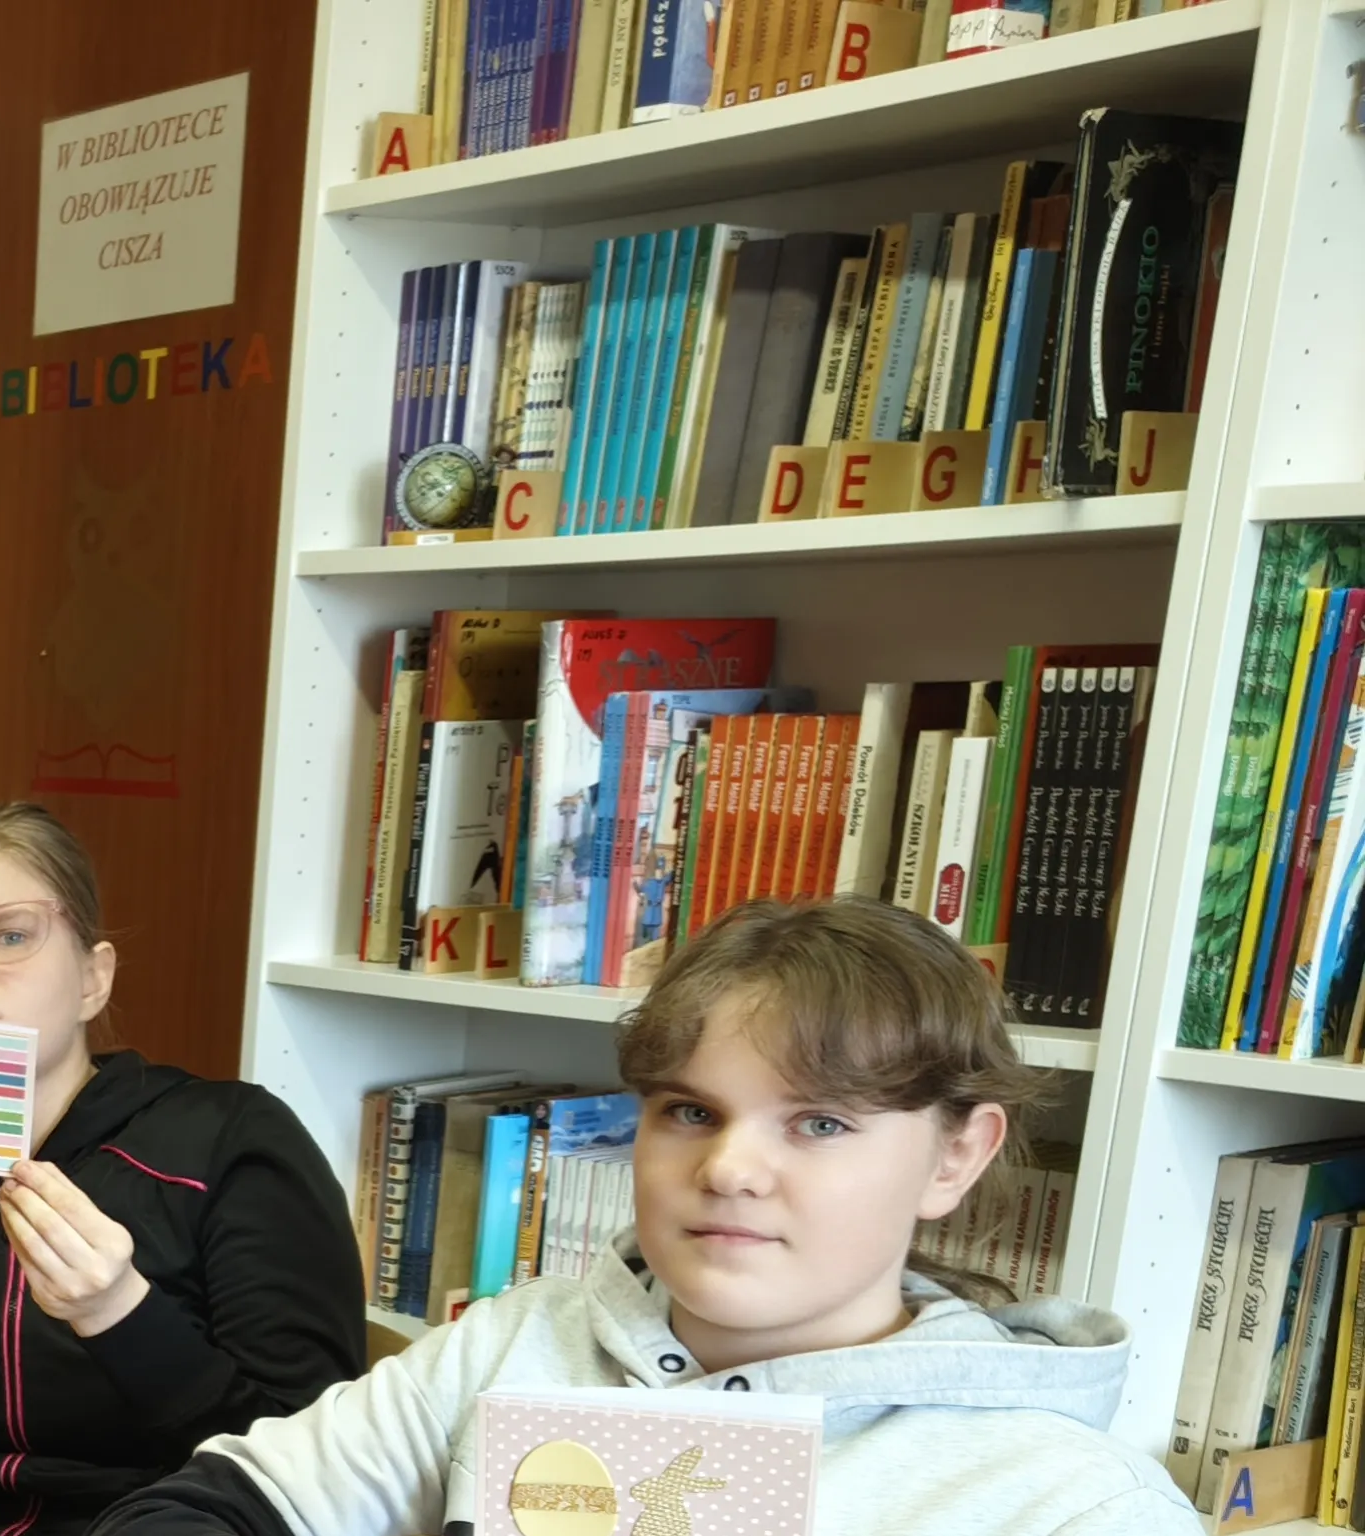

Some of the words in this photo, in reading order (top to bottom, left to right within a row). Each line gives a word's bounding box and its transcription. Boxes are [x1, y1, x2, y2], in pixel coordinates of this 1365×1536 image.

[839, 22, 871, 82] B
[56, 141, 79, 173] W
[79, 104, 228, 167] BIBLIOTECE
[378, 127, 412, 176] A
[59, 164, 217, 225] OBOWIĄZUJE
[98, 232, 165, 271] CISZA
[877, 240, 901, 321] ROBINSONA
[1125, 225, 1159, 394] PINOKIO
[1, 331, 274, 418] BIBLIOTEKA
[838, 455, 872, 509] E
[921, 446, 957, 503] G
[1129, 428, 1157, 488] J
[503, 480, 534, 532] C
[770, 460, 805, 516] D
[709, 742, 724, 778] Ferenc
[731, 744, 746, 778] Ferenc
[753, 741, 769, 775] Ferenc
[775, 743, 792, 778] Ferenc
[429, 916, 461, 963] K
[485, 924, 509, 970] L
[1042, 1188, 1061, 1246] KANGURÓW
[1035, 1246, 1052, 1284] KRAINIE
[1196, 1285, 1219, 1332] PRZEZ
[1237, 1285, 1261, 1344] PRZEZ
[1221, 1466, 1255, 1522] A
